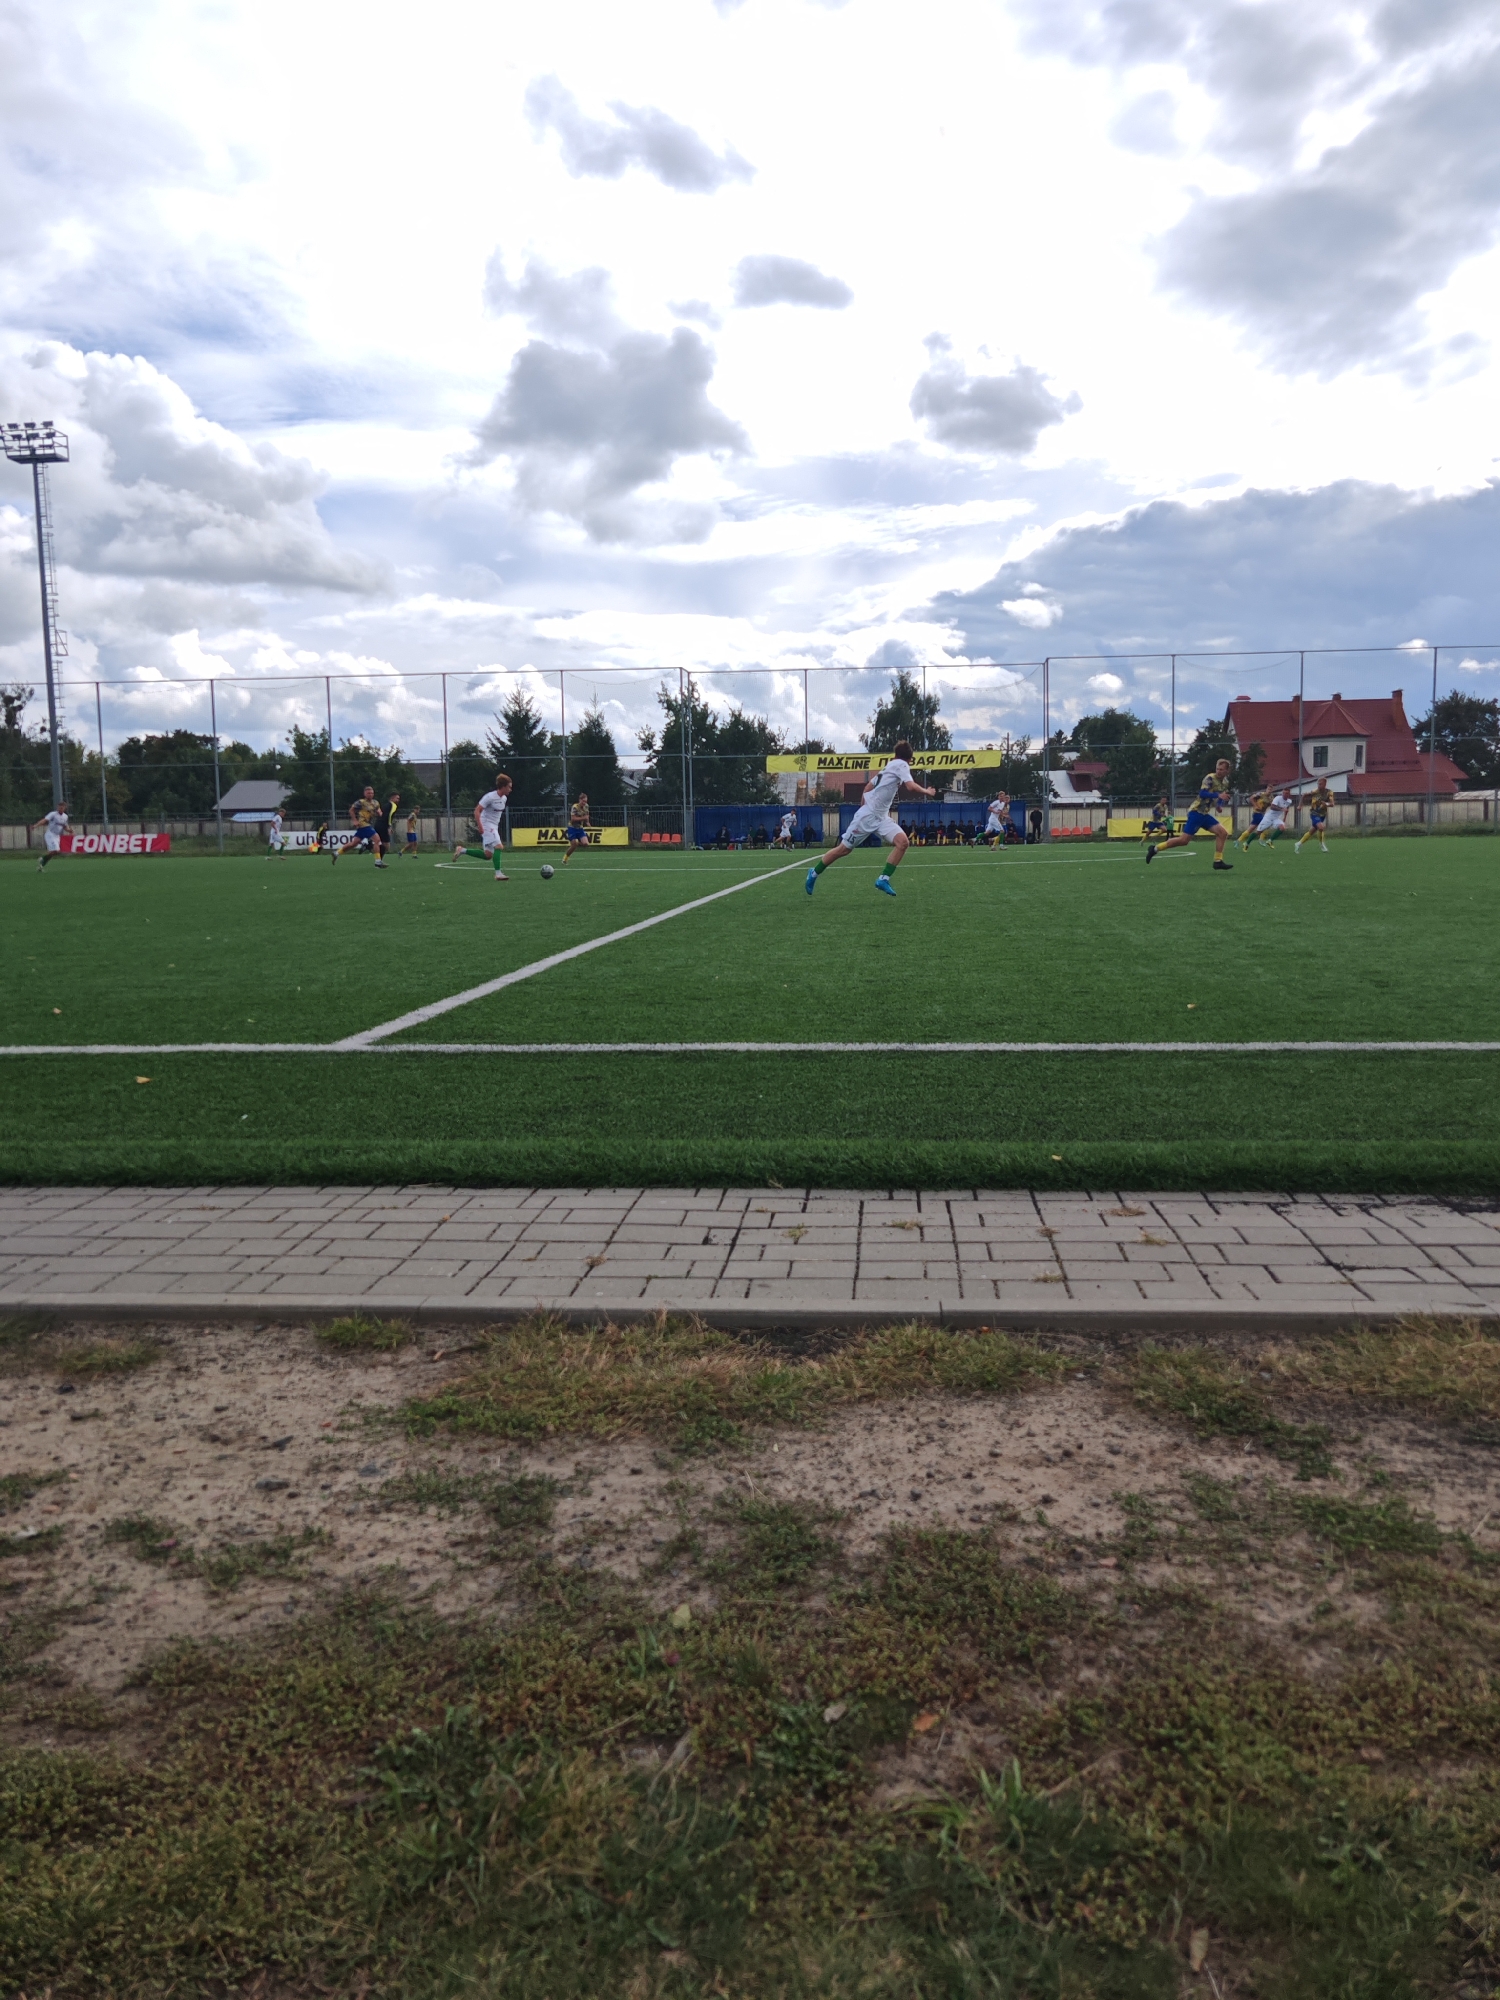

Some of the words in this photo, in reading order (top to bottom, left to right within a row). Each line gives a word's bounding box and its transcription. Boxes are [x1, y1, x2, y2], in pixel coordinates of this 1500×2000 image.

[817, 756, 871, 770] MAXLINE
[878, 755, 935, 767] ПВАЯ
[938, 754, 976, 765] ЛИГА
[71, 833, 158, 853] FONBET
[537, 828, 603, 844] MAXNE
